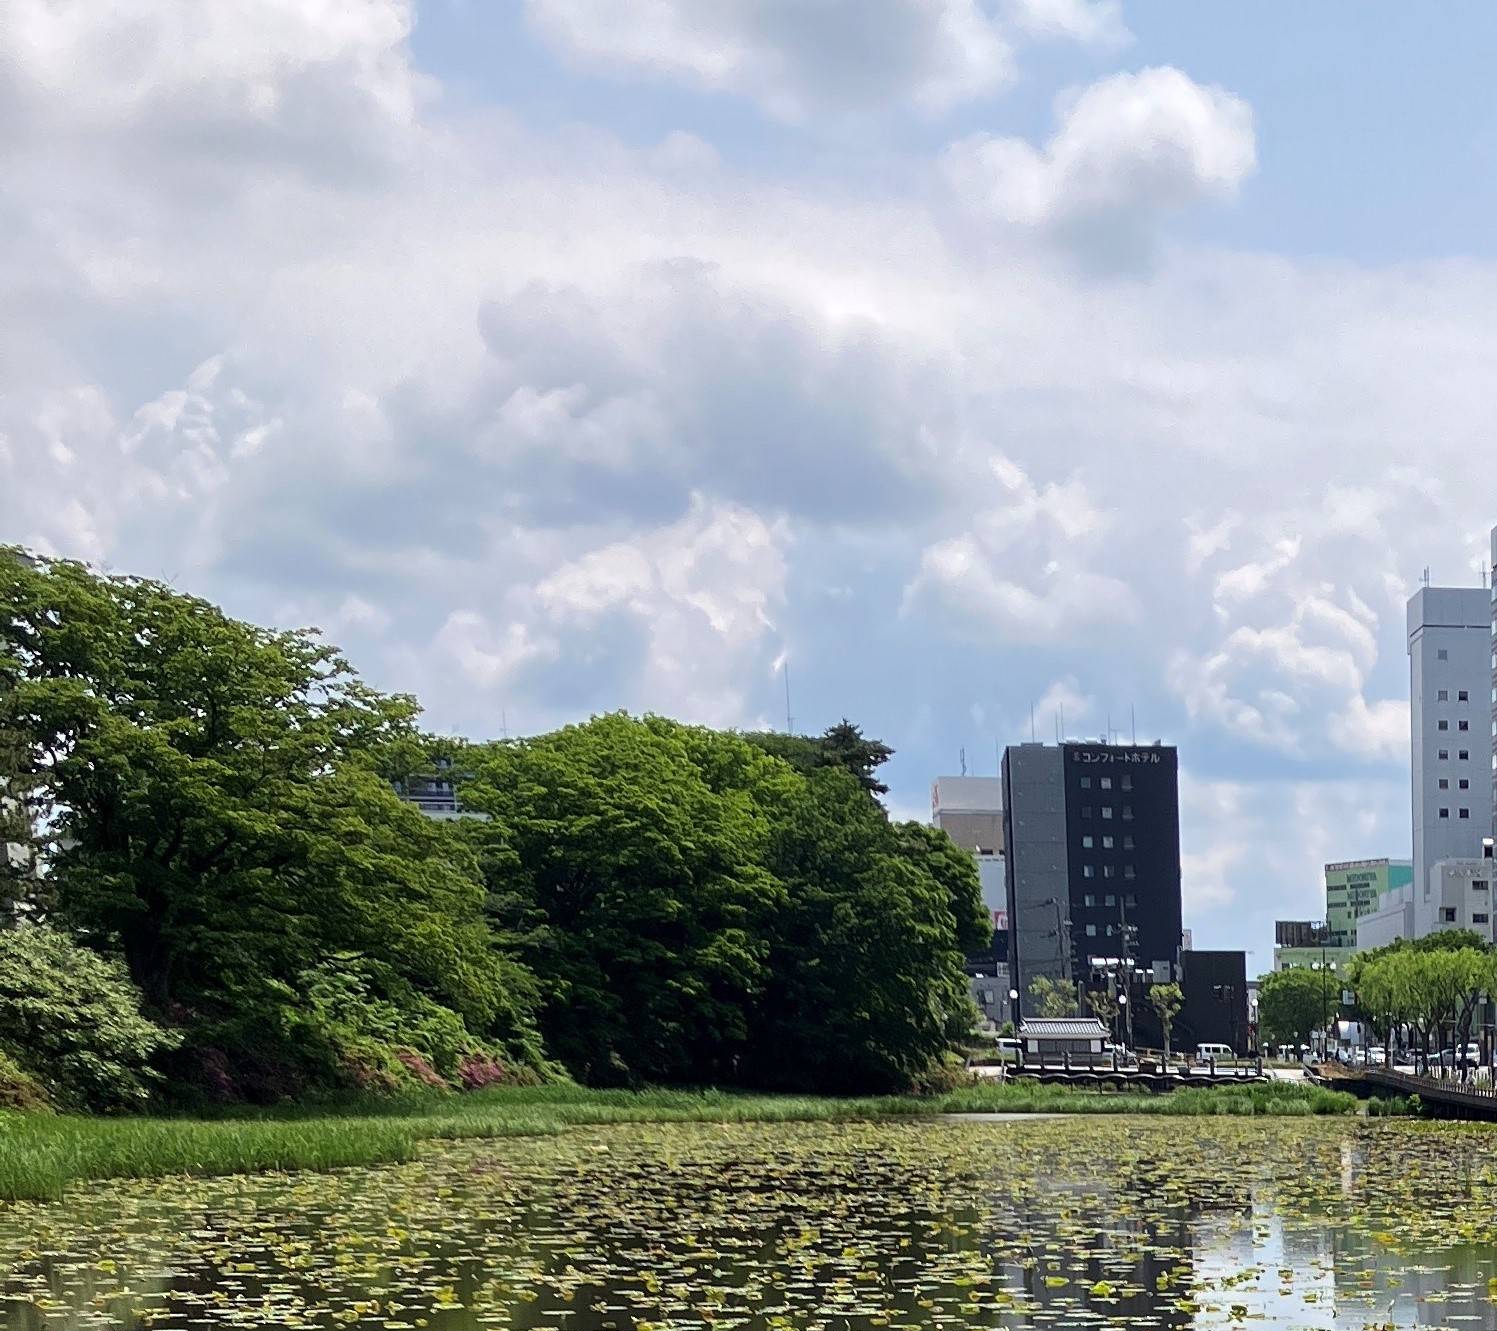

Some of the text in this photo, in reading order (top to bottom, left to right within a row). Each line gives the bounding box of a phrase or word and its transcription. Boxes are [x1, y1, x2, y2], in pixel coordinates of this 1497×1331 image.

[1082, 751, 1160, 764] コンフォートホテル
